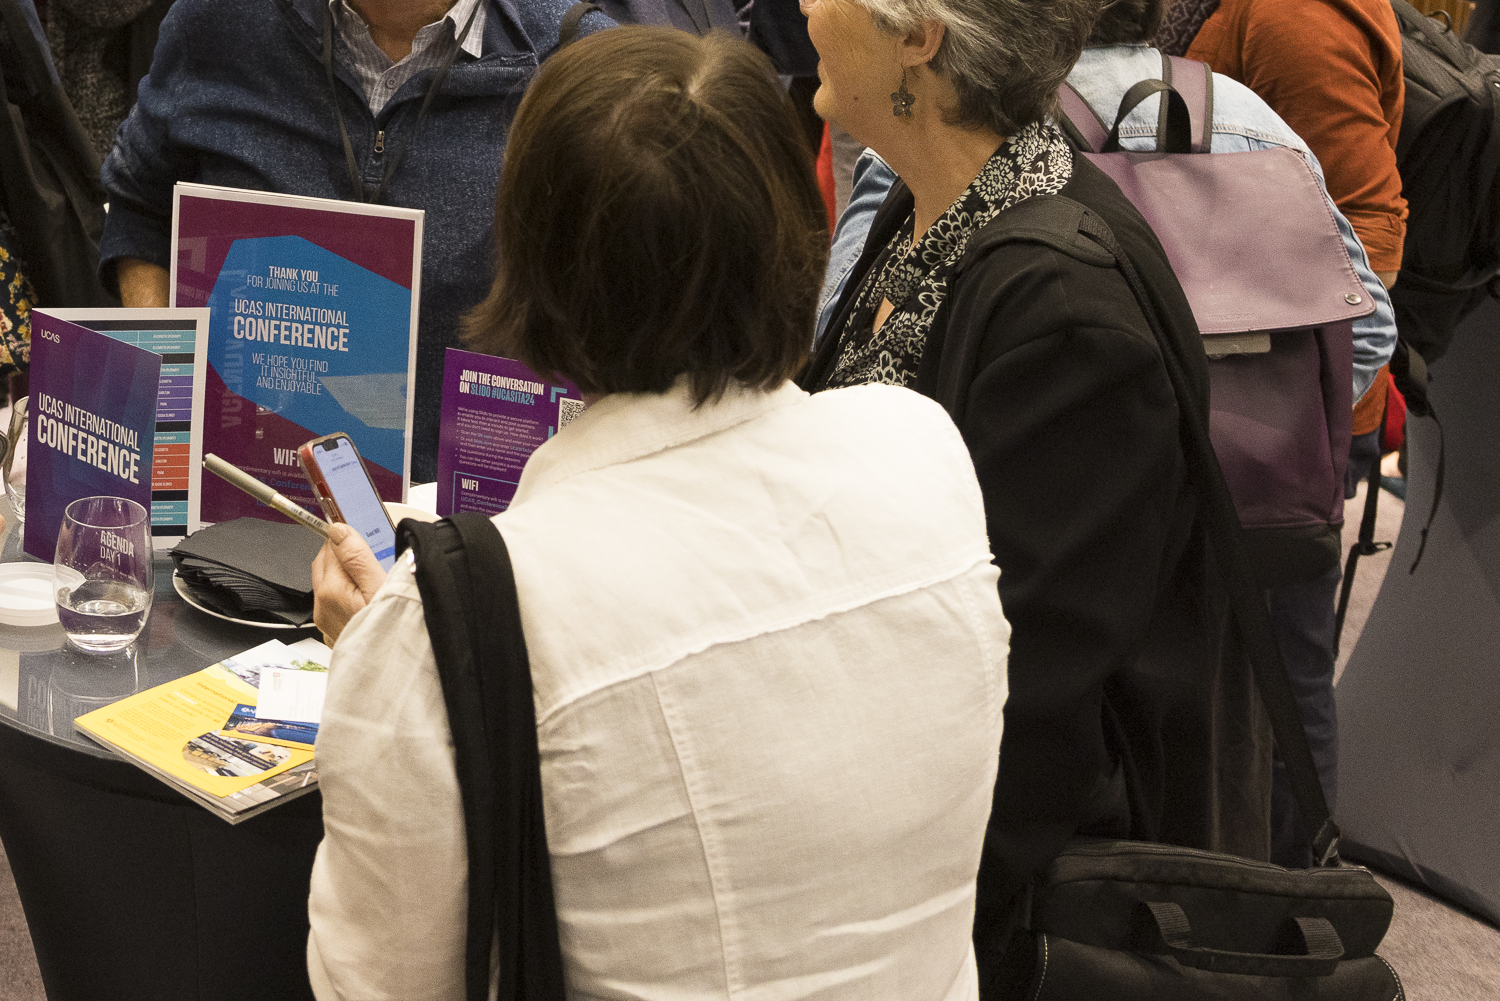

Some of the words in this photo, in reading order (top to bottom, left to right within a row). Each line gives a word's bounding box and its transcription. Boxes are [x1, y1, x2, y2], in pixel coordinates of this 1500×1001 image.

[246, 274, 264, 288] FOR
[265, 276, 296, 292] JOINING
[297, 280, 309, 293] US
[310, 281, 322, 294] AT
[323, 283, 339, 297] THE
[268, 265, 299, 281] THANK
[300, 268, 319, 283] YOU
[234, 298, 263, 316] UCAS
[265, 302, 349, 327] INTERNATIONAL
[233, 315, 350, 352] CONFERENCE
[252, 352, 266, 365] WE
[267, 354, 290, 368] HOPE
[290, 356, 308, 370] YOU
[309, 358, 329, 373] FIND
[260, 364, 270, 376] IT
[270, 366, 318, 384] INSIGHTFUL
[256, 376, 274, 389] AND
[275, 378, 322, 396] ENJOYABLE
[459, 381, 470, 394] ON
[470, 383, 491, 398] SLIDO
[491, 386, 535, 406] #UCASITA24
[460, 369, 478, 384] JOIN
[478, 372, 491, 386] THE
[491, 374, 545, 396] CONVERSATION
[38, 391, 64, 420] UCAS
[64, 402, 141, 452] INTERNATIONAL
[37, 414, 141, 485] CONFERENCE
[461, 477, 479, 491] WIFI
[100, 529, 135, 558] AGENDA
[100, 545, 115, 564] DAY
[117, 552, 122, 567] 1
